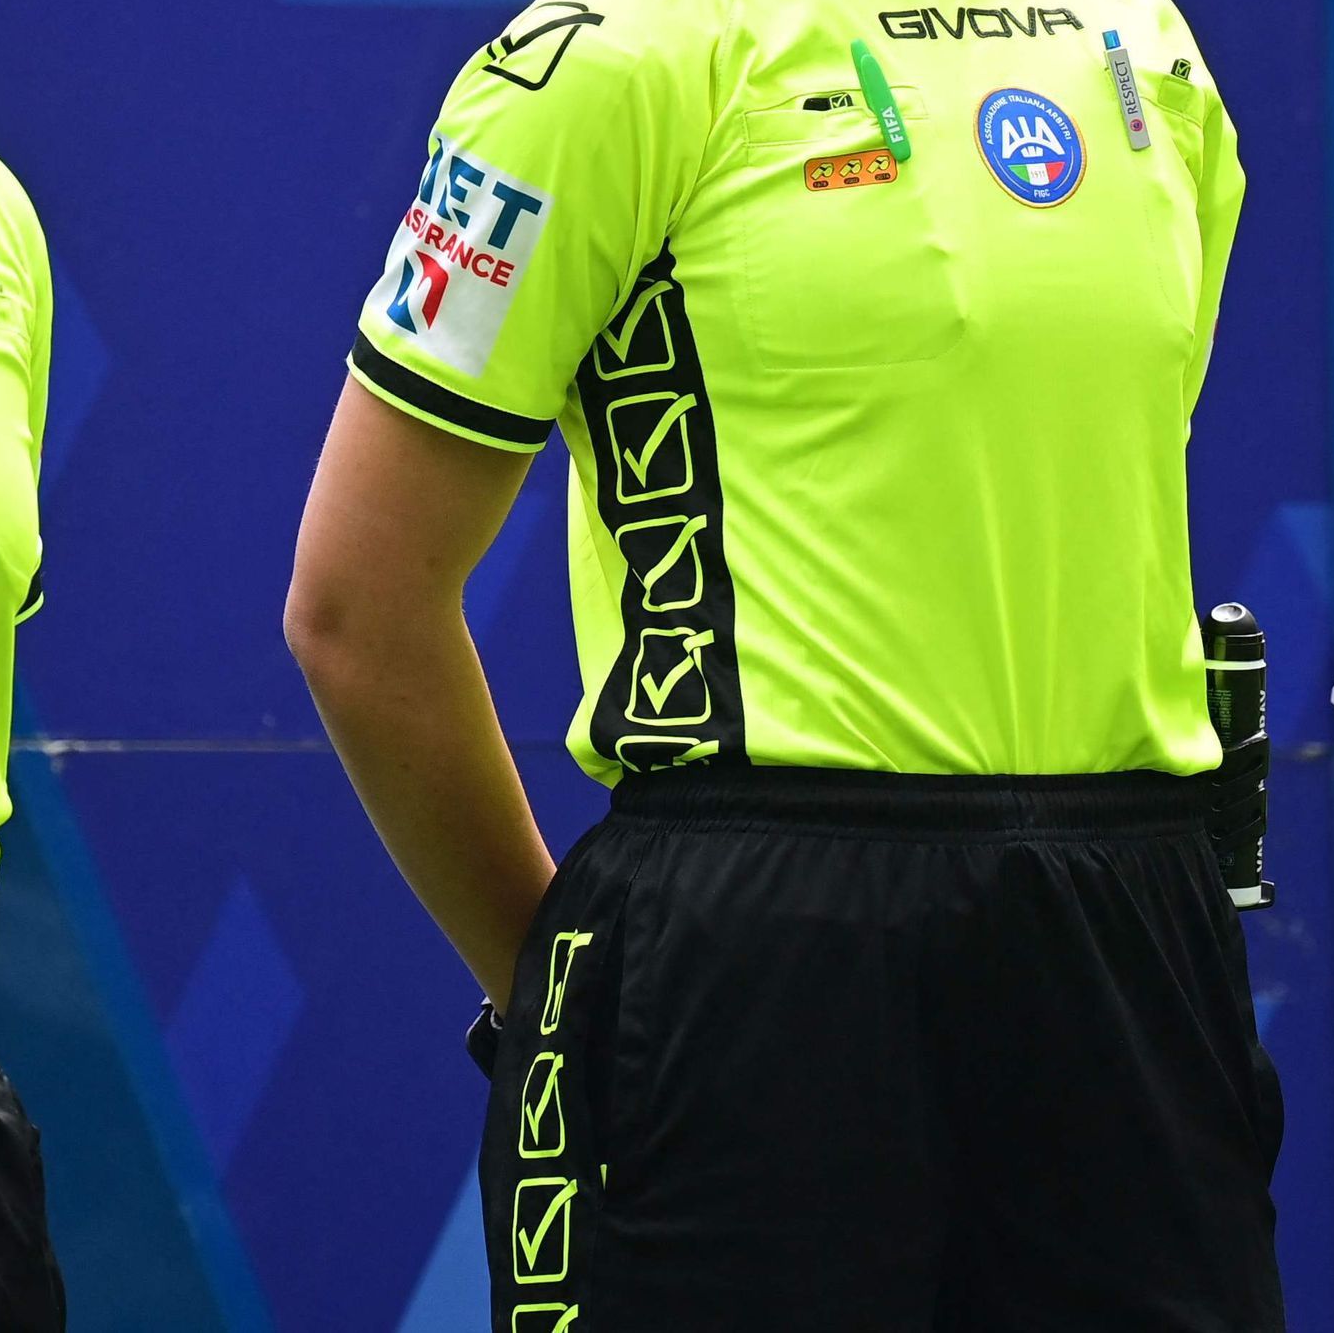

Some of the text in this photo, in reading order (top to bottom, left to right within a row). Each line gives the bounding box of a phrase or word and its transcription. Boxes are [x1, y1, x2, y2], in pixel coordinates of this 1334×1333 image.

[878, 7, 1085, 40] GIVOVA
[1114, 60, 1139, 115] RESPECT
[881, 106, 905, 144] FIFA
[984, 94, 1072, 145] ASSOCIAZIONE ITALIANA ARBITRI
[404, 207, 515, 288] SURANCE
